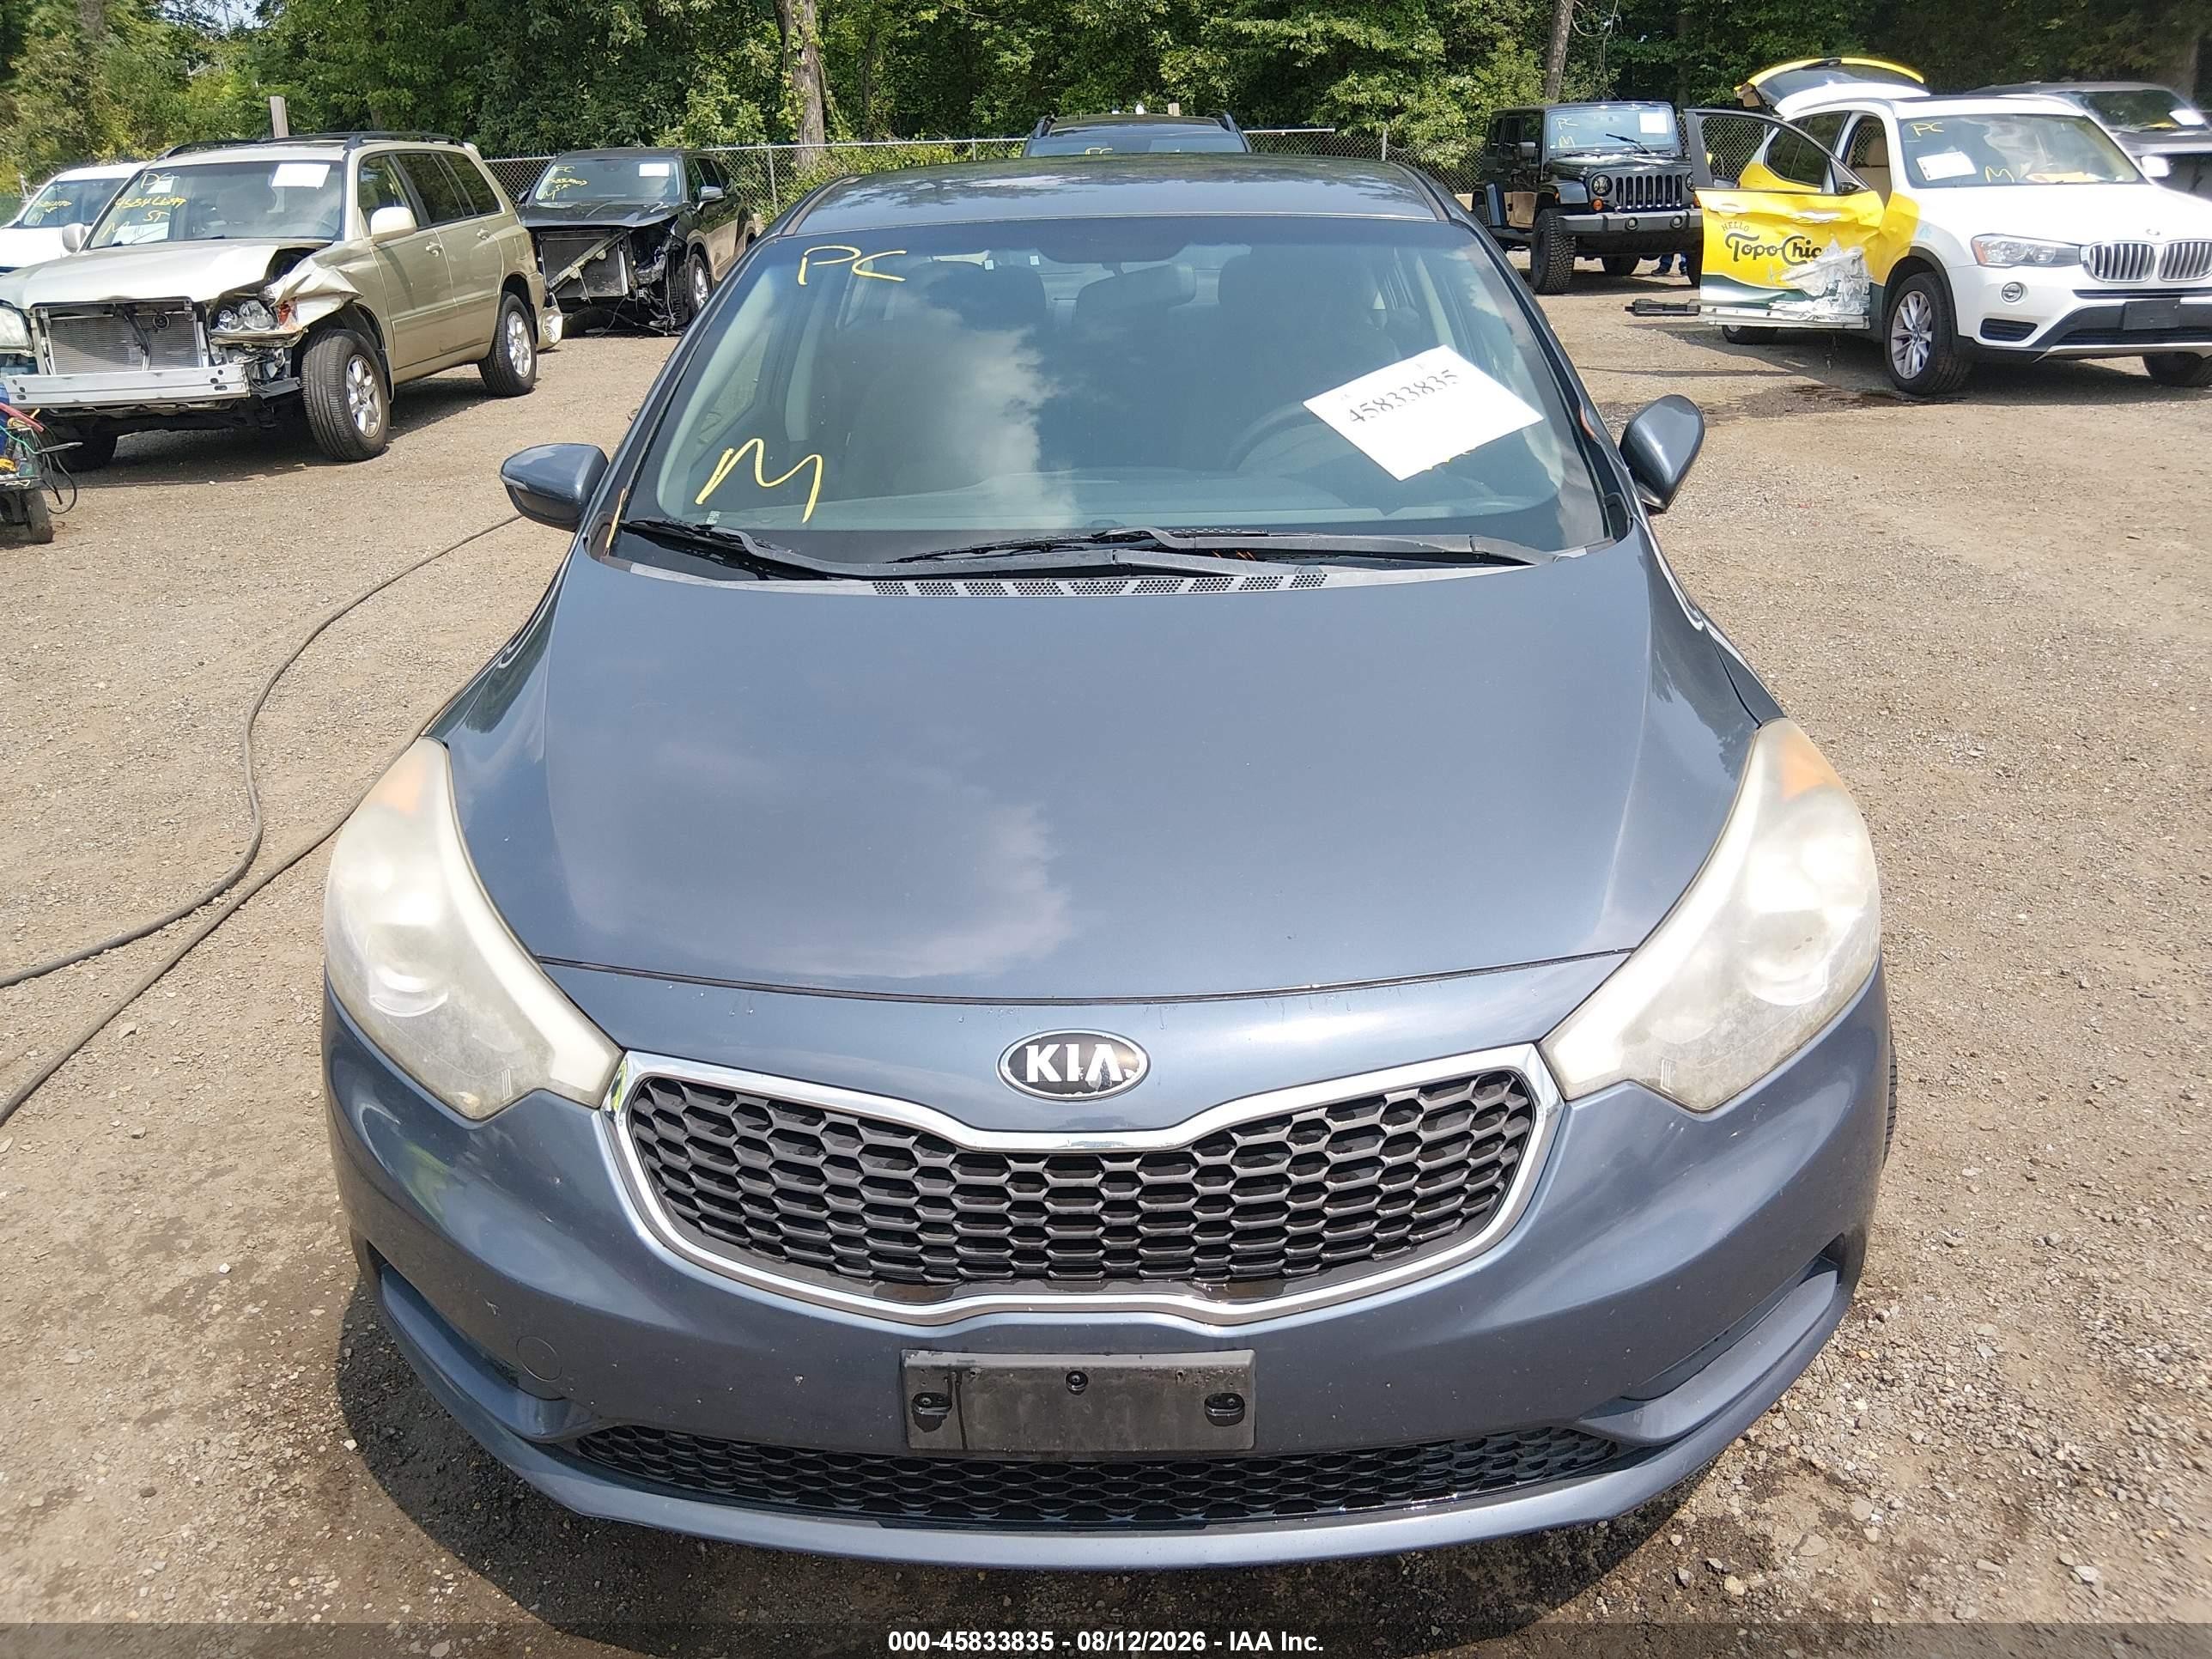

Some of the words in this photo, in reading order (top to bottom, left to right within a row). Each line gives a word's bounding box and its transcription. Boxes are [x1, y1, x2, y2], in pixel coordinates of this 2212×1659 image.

[1911, 122, 1945, 137] PC
[1984, 166, 2014, 183] M
[1721, 222, 1750, 233] HELLO
[797, 245, 908, 286] PC
[1724, 232, 1783, 263] Topo
[1349, 369, 1458, 422] 45833835
[695, 437, 824, 523] M
[1025, 1042, 1124, 1084] KIA
